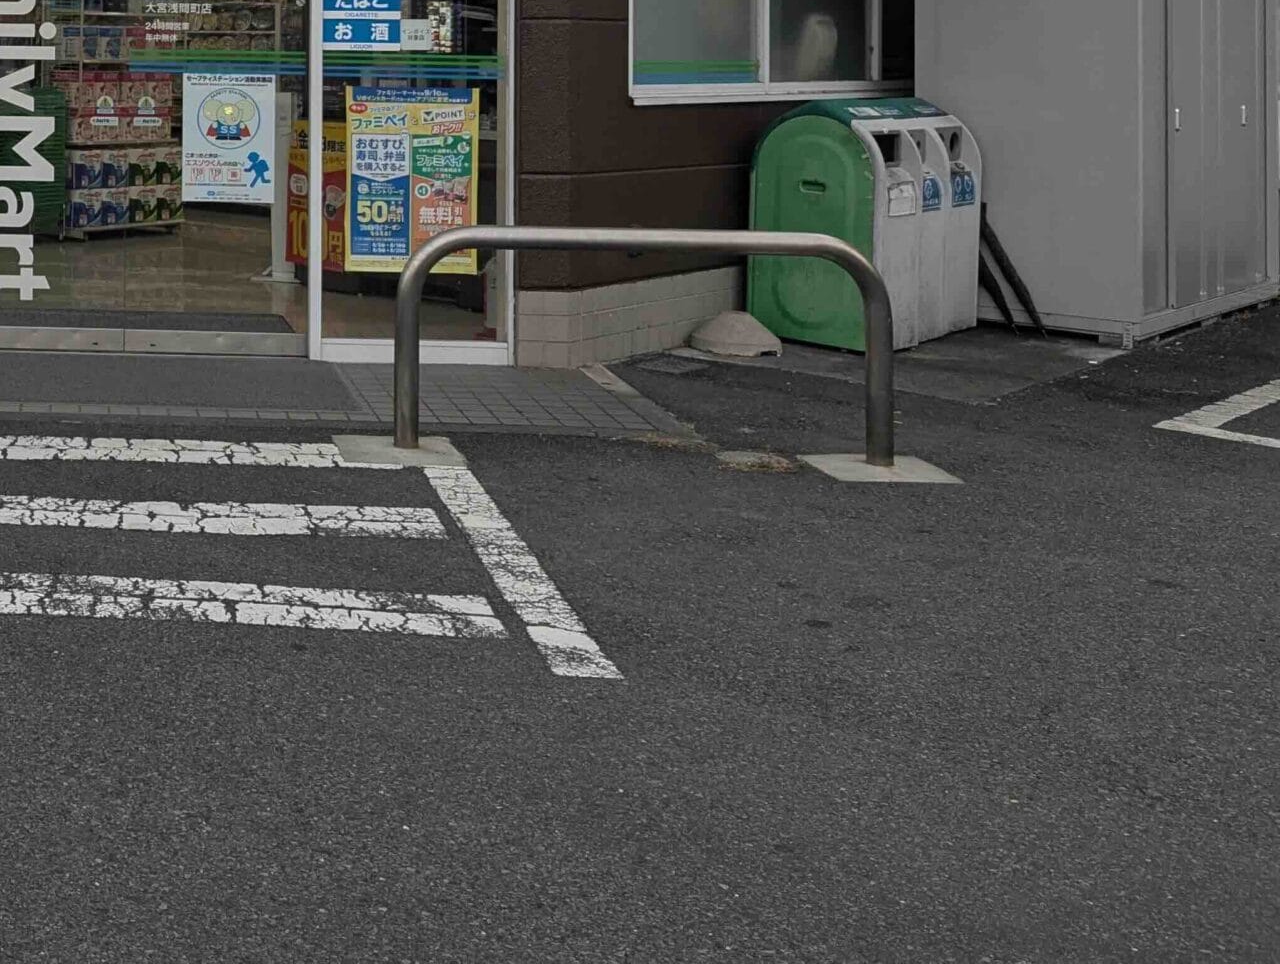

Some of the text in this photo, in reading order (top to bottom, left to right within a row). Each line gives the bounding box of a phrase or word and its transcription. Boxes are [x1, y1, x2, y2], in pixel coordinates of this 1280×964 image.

[352, 114, 407, 129] ファミペイ
[220, 125, 237, 134] SS
